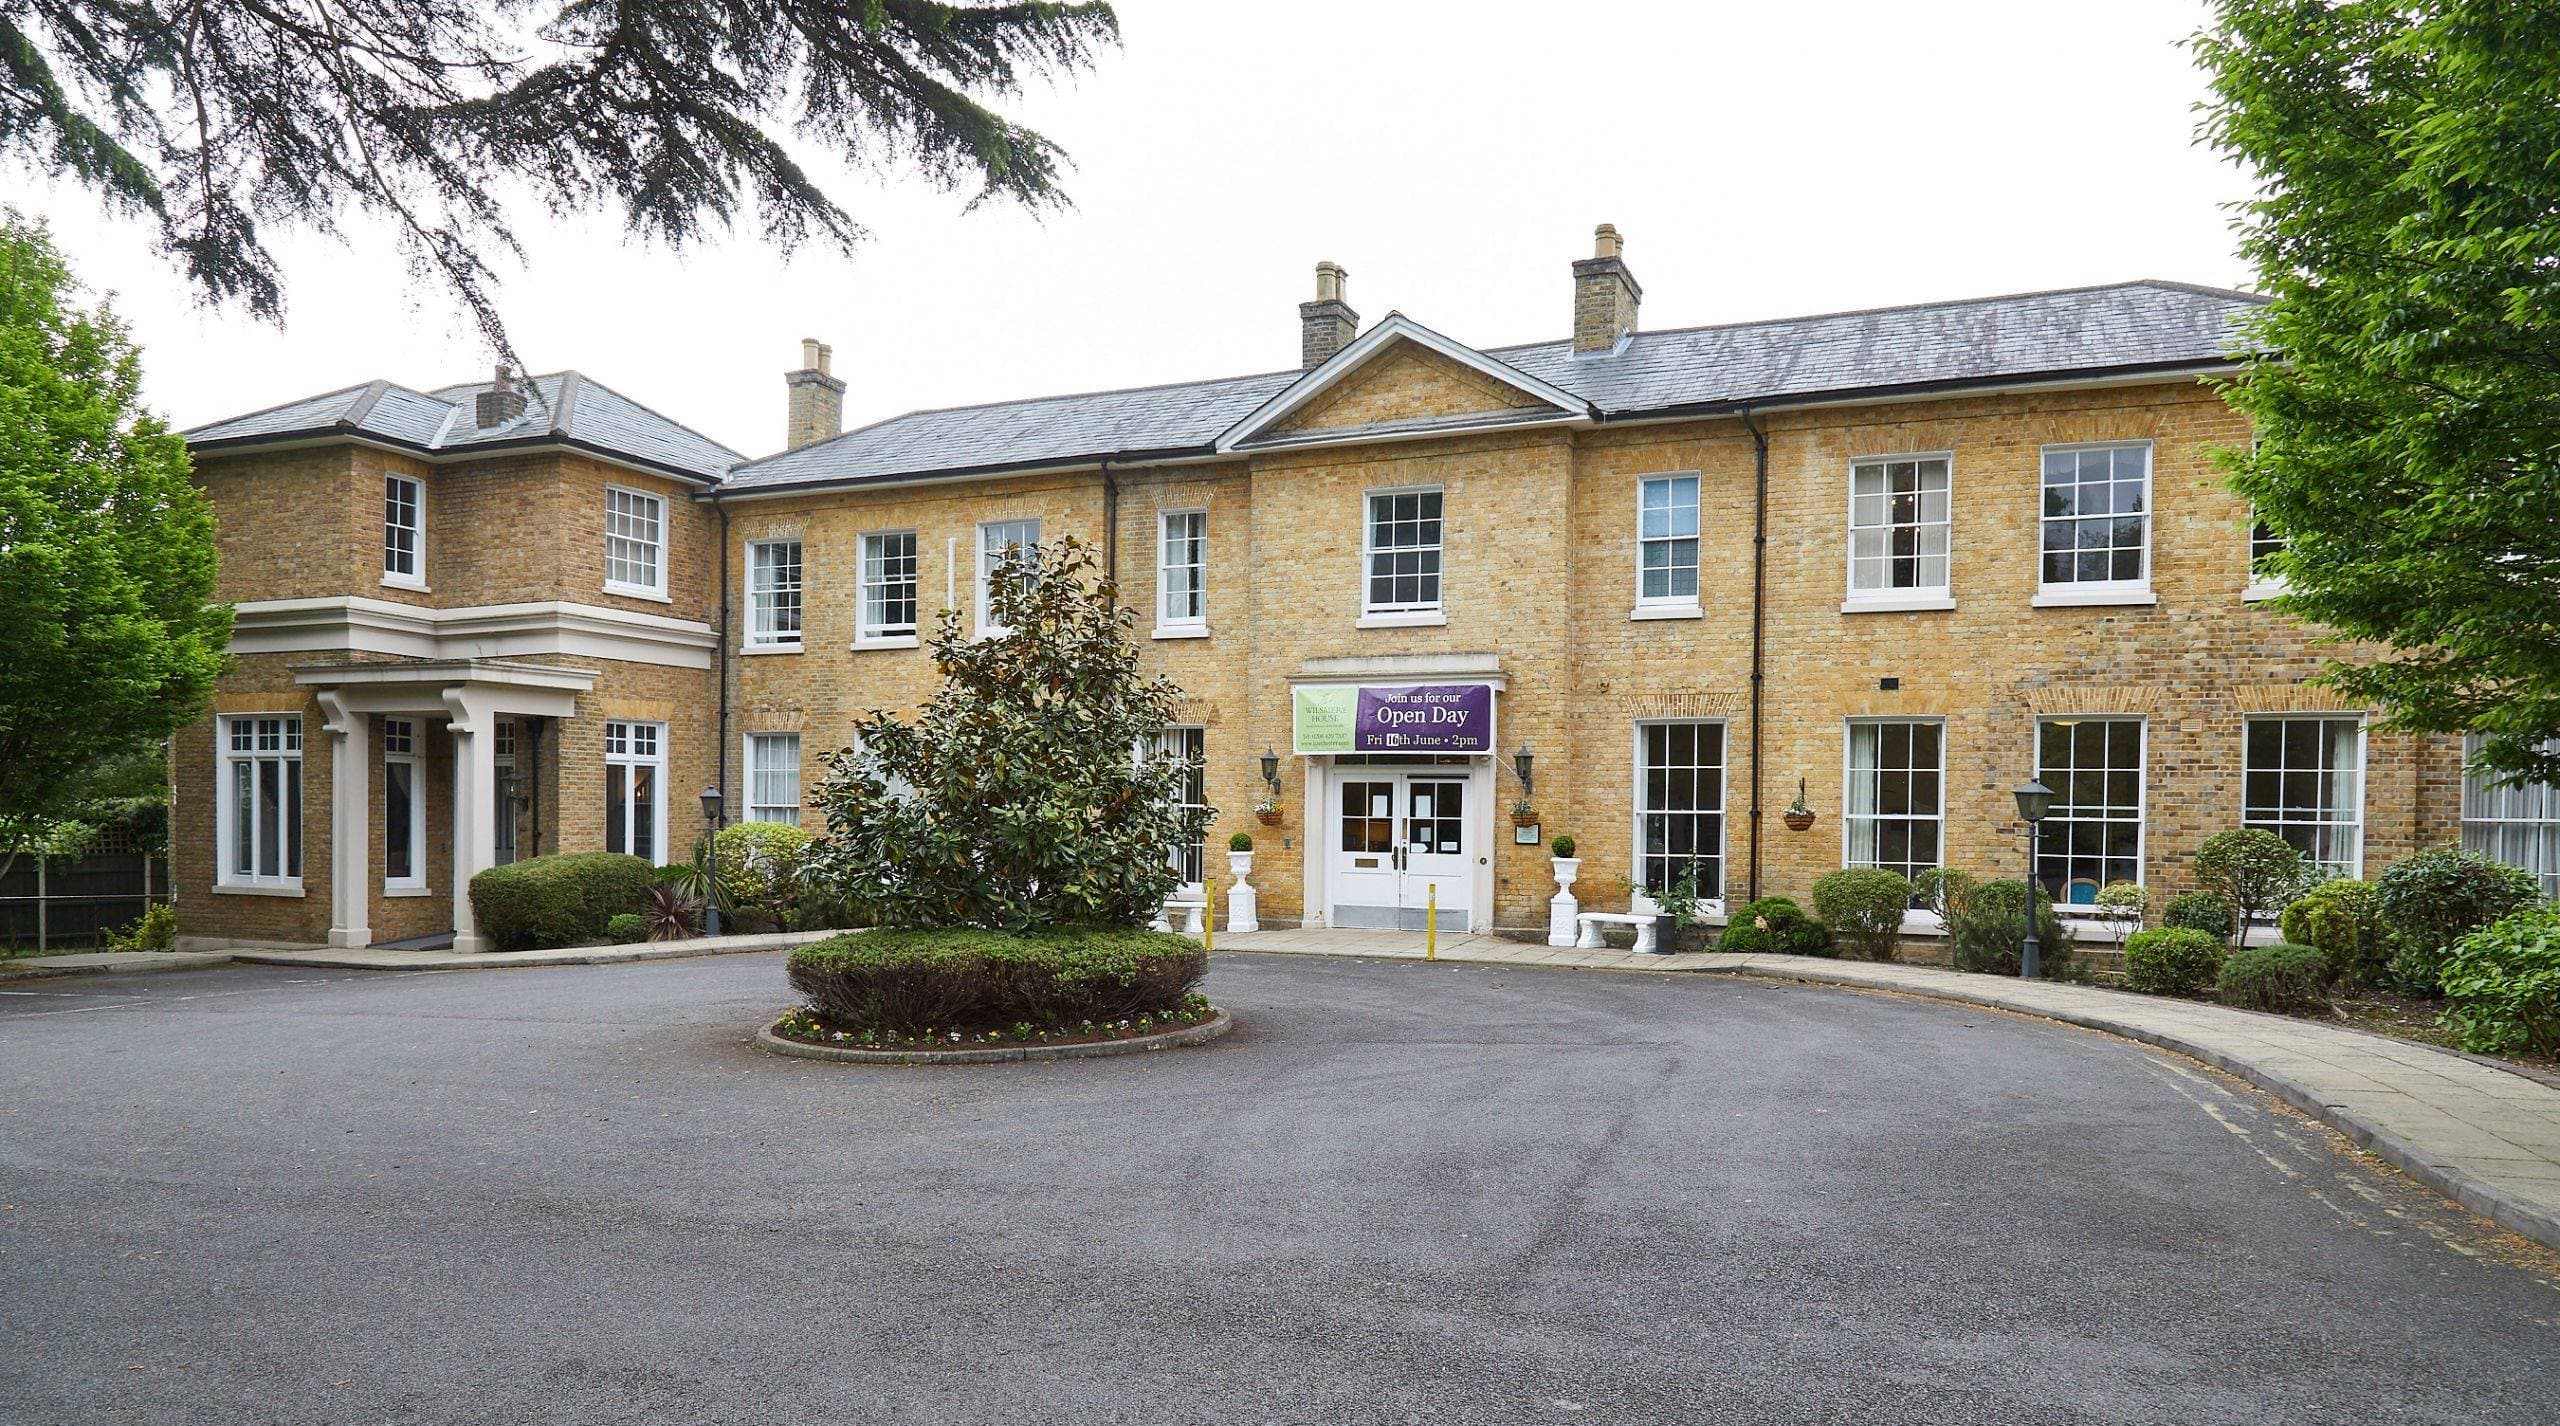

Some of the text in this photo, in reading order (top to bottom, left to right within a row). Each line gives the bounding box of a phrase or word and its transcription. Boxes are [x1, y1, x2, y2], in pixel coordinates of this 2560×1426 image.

[1385, 692, 1462, 703] Join us for our
[1377, 706, 1469, 727] Open Day
[1367, 734, 1382, 745] Fri
[1413, 734, 1441, 745] June
[1452, 734, 1478, 747] 2pm
